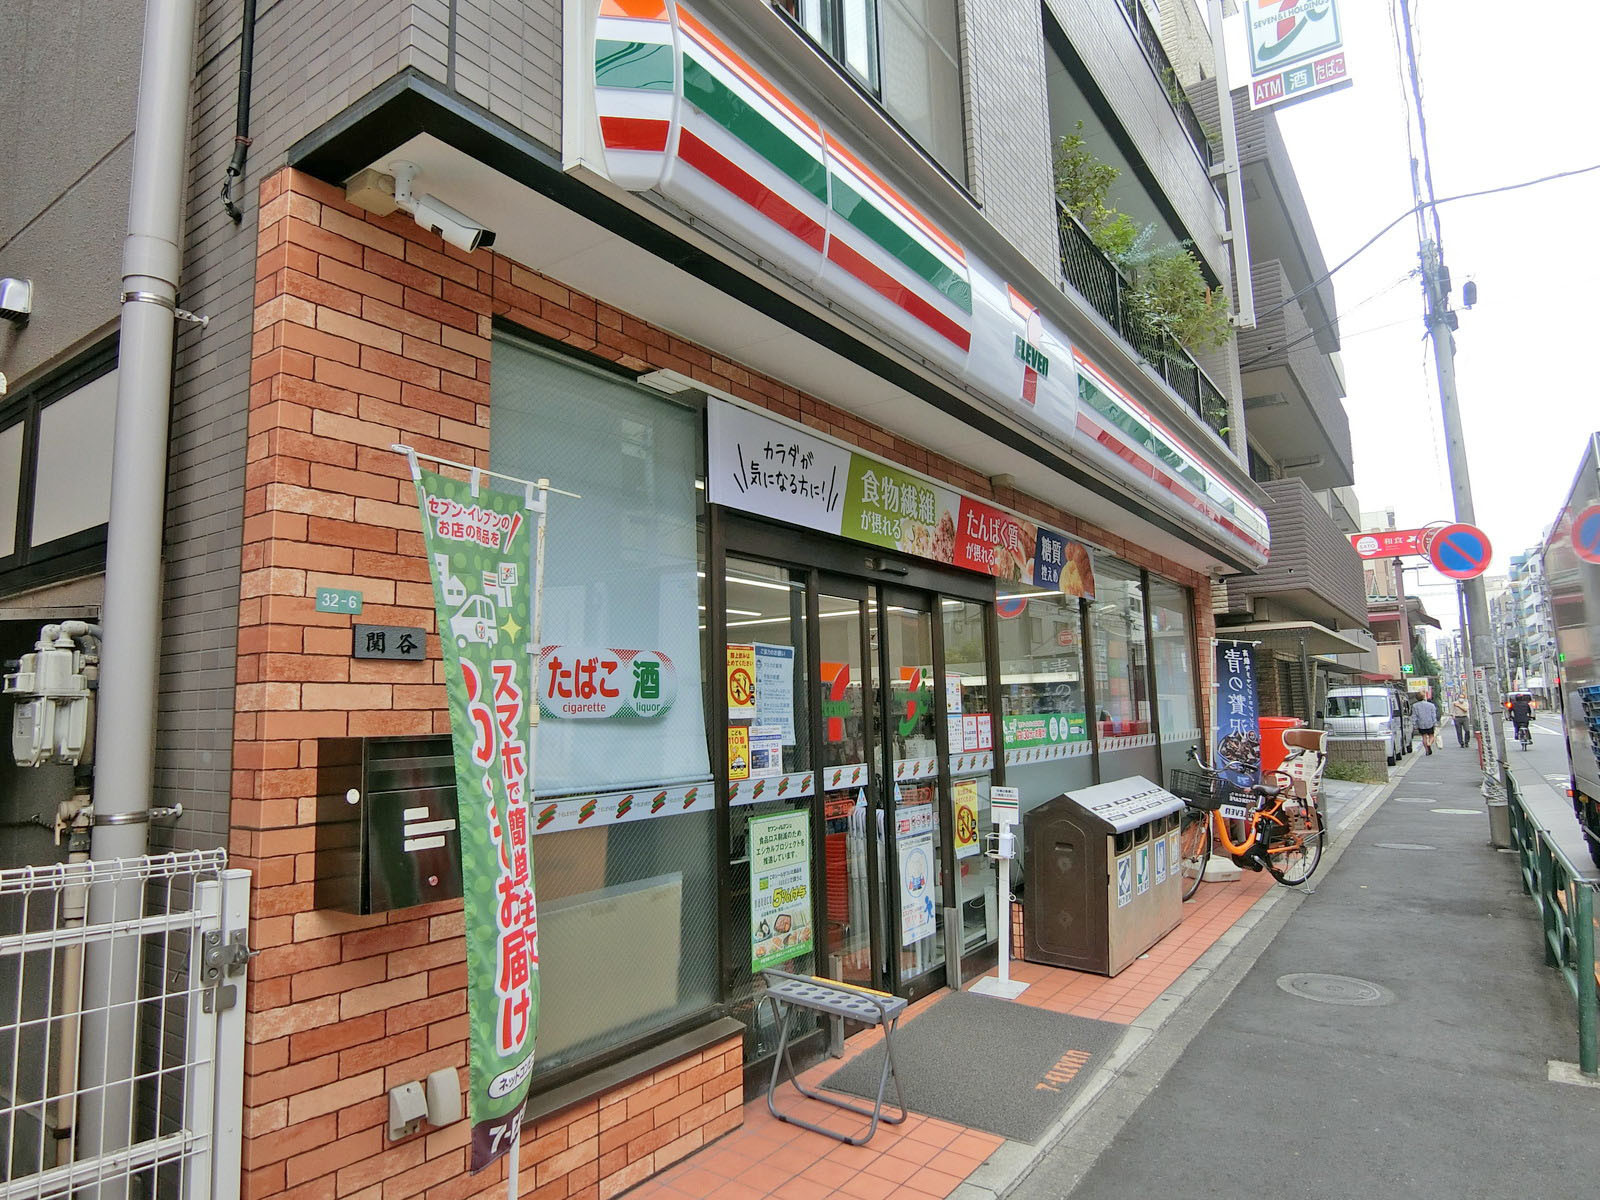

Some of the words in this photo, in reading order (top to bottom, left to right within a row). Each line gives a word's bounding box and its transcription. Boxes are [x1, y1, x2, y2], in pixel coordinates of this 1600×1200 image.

[1289, 69, 1308, 90] 酒
[1315, 59, 1345, 81] たばこ
[1256, 78, 1281, 100] ATM
[763, 440, 814, 470] カラダが
[750, 461, 826, 502] 気になる方に!
[860, 469, 936, 526] 食物繊維
[438, 520, 500, 546] お店の商品を
[860, 510, 901, 541] が摂れる
[966, 543, 996, 567] が摂れる
[1040, 536, 1063, 565] 糖質
[1040, 562, 1060, 583] 控えめ
[321, 593, 358, 609] 32-6
[366, 631, 419, 655] 関谷
[548, 656, 620, 699] たばこ
[633, 660, 660, 699] 酒
[562, 702, 606, 714] cigarette
[636, 702, 661, 713] liquor
